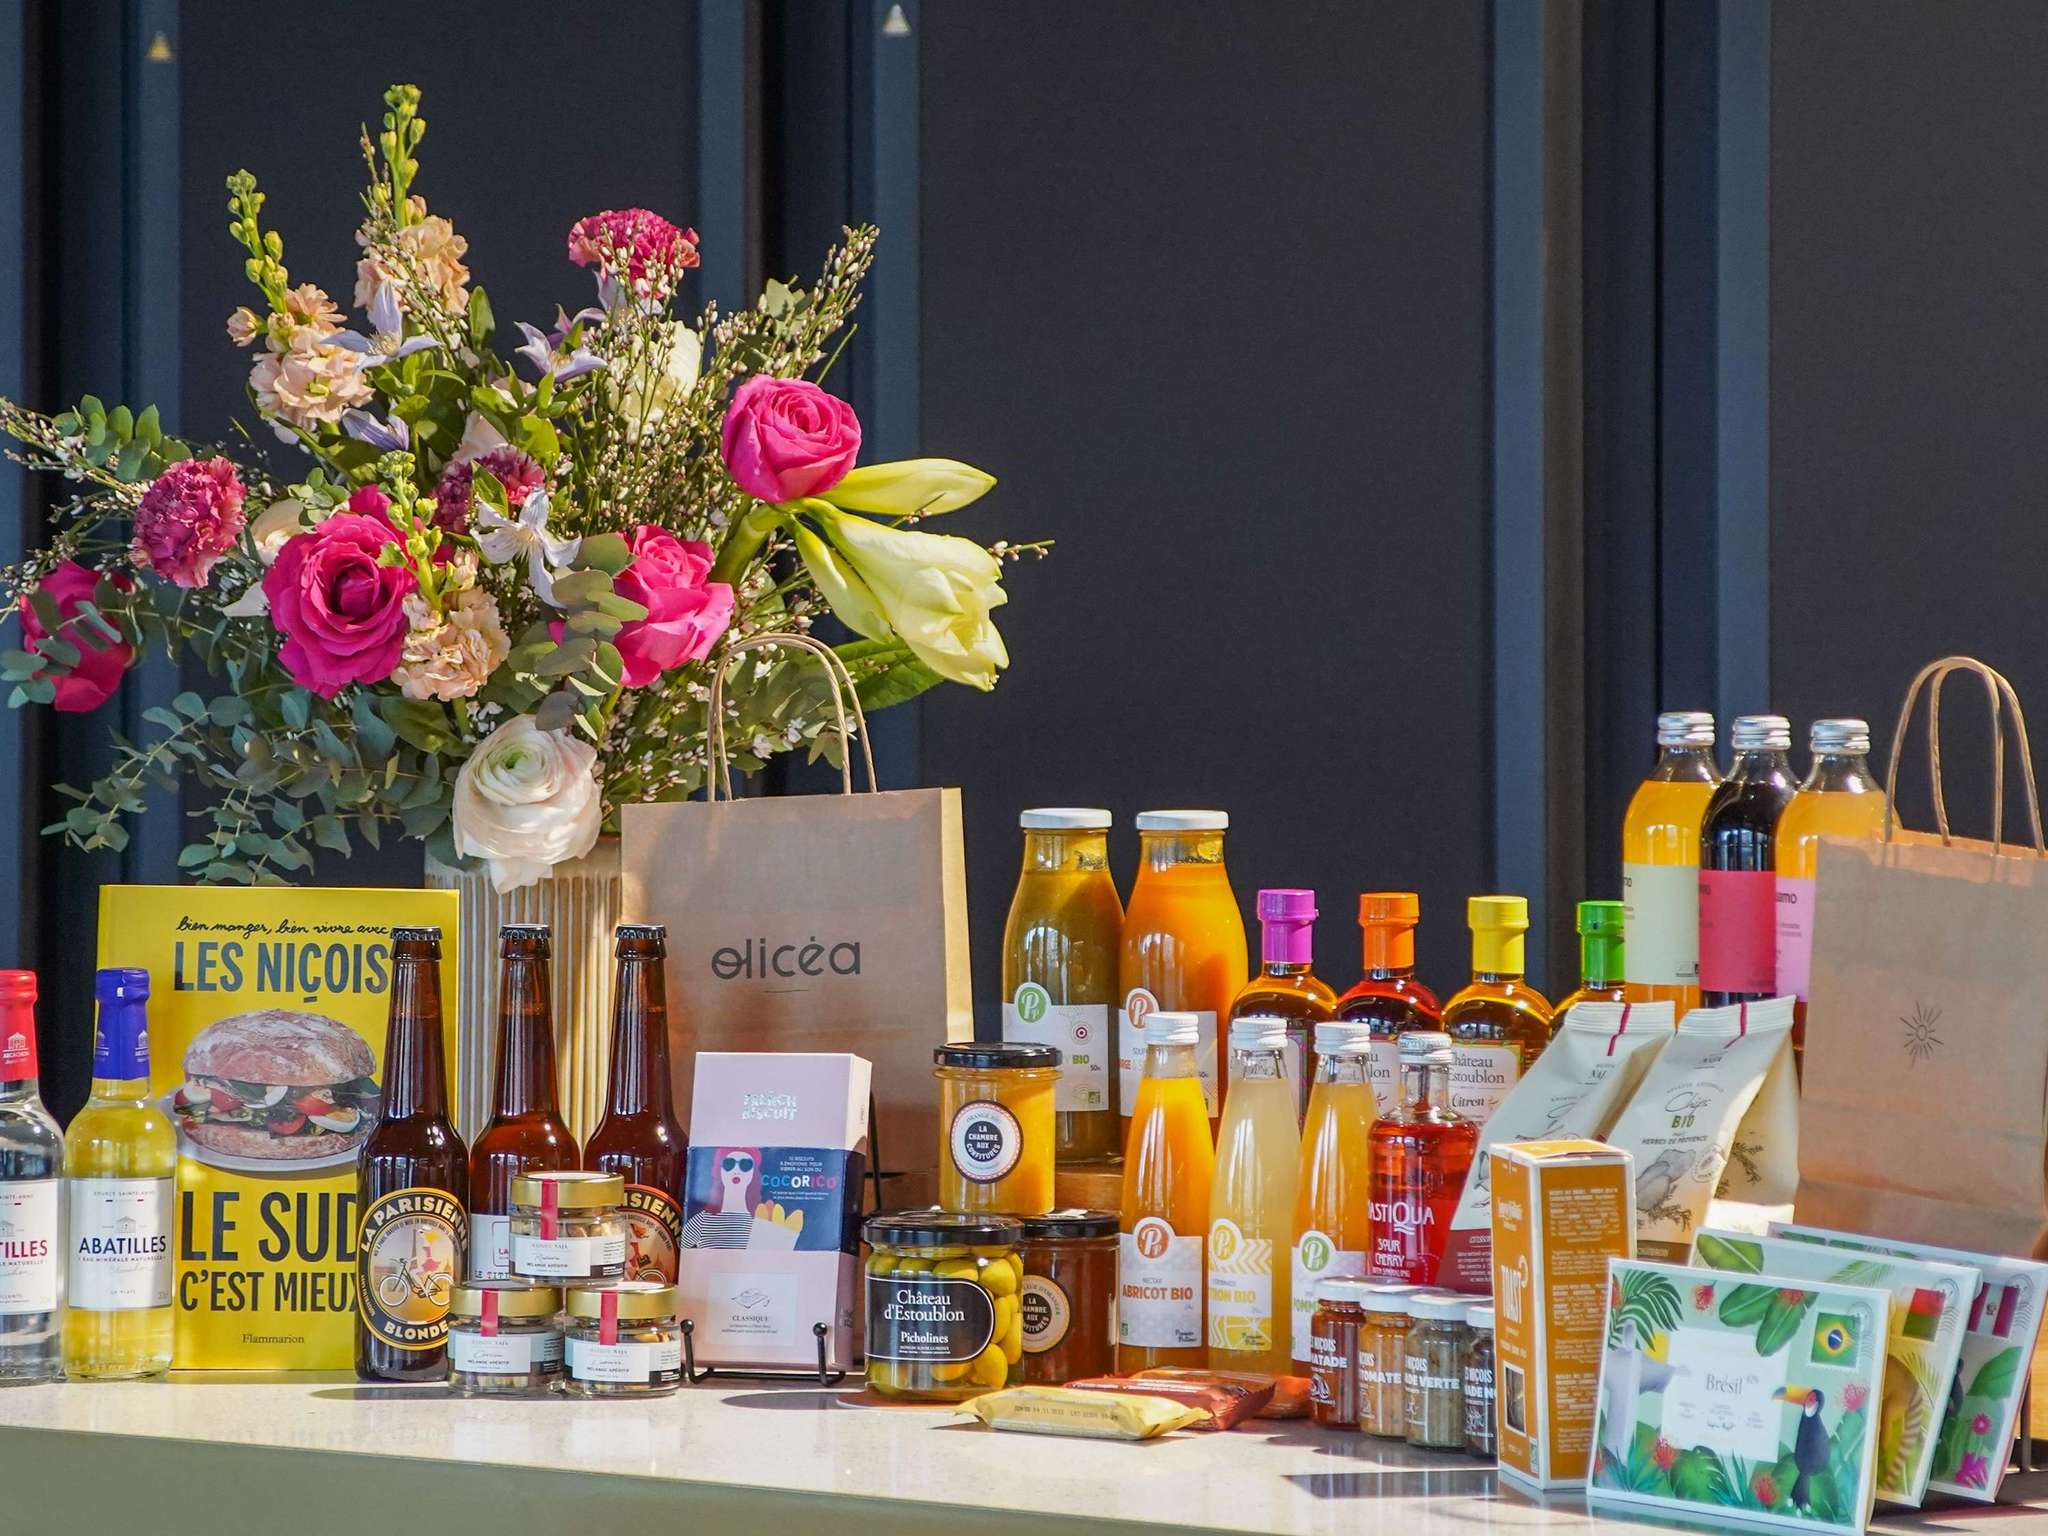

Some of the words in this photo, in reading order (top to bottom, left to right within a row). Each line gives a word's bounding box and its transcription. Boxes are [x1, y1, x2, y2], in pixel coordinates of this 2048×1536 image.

[176, 916, 208, 931] bien
[211, 922, 272, 939] manger,
[275, 919, 308, 934] bien
[313, 923, 353, 934] vivre
[357, 925, 389, 935] avec
[174, 942, 243, 992] LES
[257, 943, 390, 1003] NIÇOIS
[1072, 1054, 1089, 1064] BIO
[1672, 1115, 1695, 1128] BIO
[968, 1133, 999, 1141] CHAMBRE
[966, 1143, 1001, 1160] CONFITURES
[181, 1191, 240, 1261] LE
[258, 1191, 357, 1262] SUD
[79, 1235, 166, 1254] ABATILLES
[361, 1228, 377, 1253] LA
[1377, 1238, 1401, 1252] SOUR
[180, 1269, 264, 1311] C'EST
[897, 1289, 951, 1305] Château
[1122, 1284, 1168, 1300] ABRICOT
[1170, 1287, 1193, 1300] BIO
[1234, 1289, 1257, 1303] BIO
[1028, 1297, 1037, 1305] LA
[884, 1303, 966, 1321] d'Estoublon
[383, 1319, 449, 1341] BLONDE
[900, 1331, 949, 1344] Picholines
[242, 1333, 305, 1344] Flammarion
[1419, 1375, 1460, 1390] VERTE
[1705, 1374, 1744, 1395] Brésil
